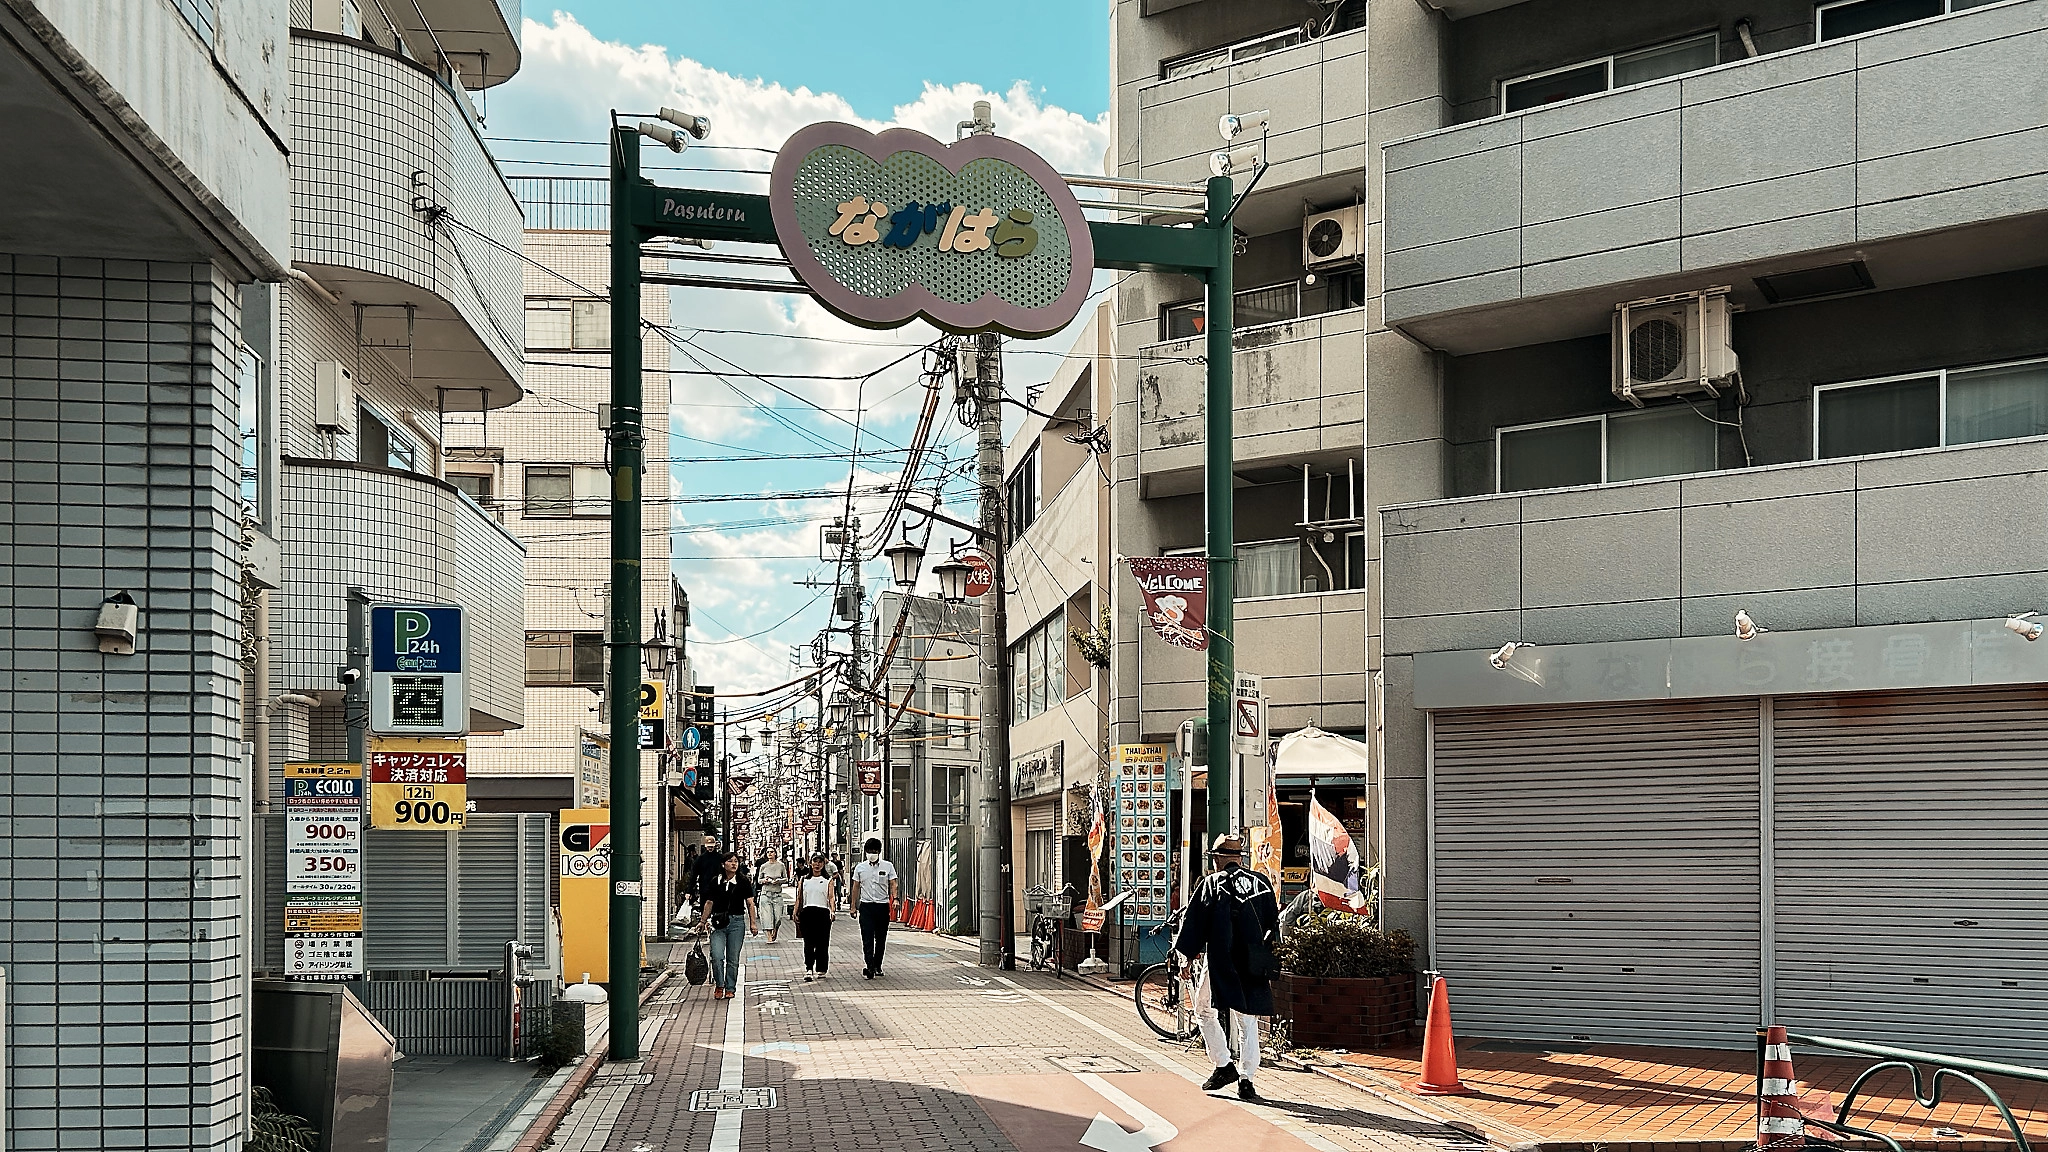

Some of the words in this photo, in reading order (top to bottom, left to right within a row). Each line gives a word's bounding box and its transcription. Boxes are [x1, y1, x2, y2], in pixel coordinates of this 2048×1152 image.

[663, 198, 745, 222] Pasuteru
[828, 195, 1039, 258] ながはら
[1136, 573, 1204, 591] WELCOME
[410, 640, 440, 654] 24h
[1125, 747, 1141, 755] THAI
[1145, 746, 1162, 755] THAI
[373, 753, 465, 768] キャッシュレス
[327, 767, 351, 775] 2.2m
[390, 768, 448, 783] 決済対応
[406, 787, 432, 799] 12h
[394, 800, 464, 825] 900円
[305, 824, 356, 841] 900円
[304, 856, 356, 873] 350円
